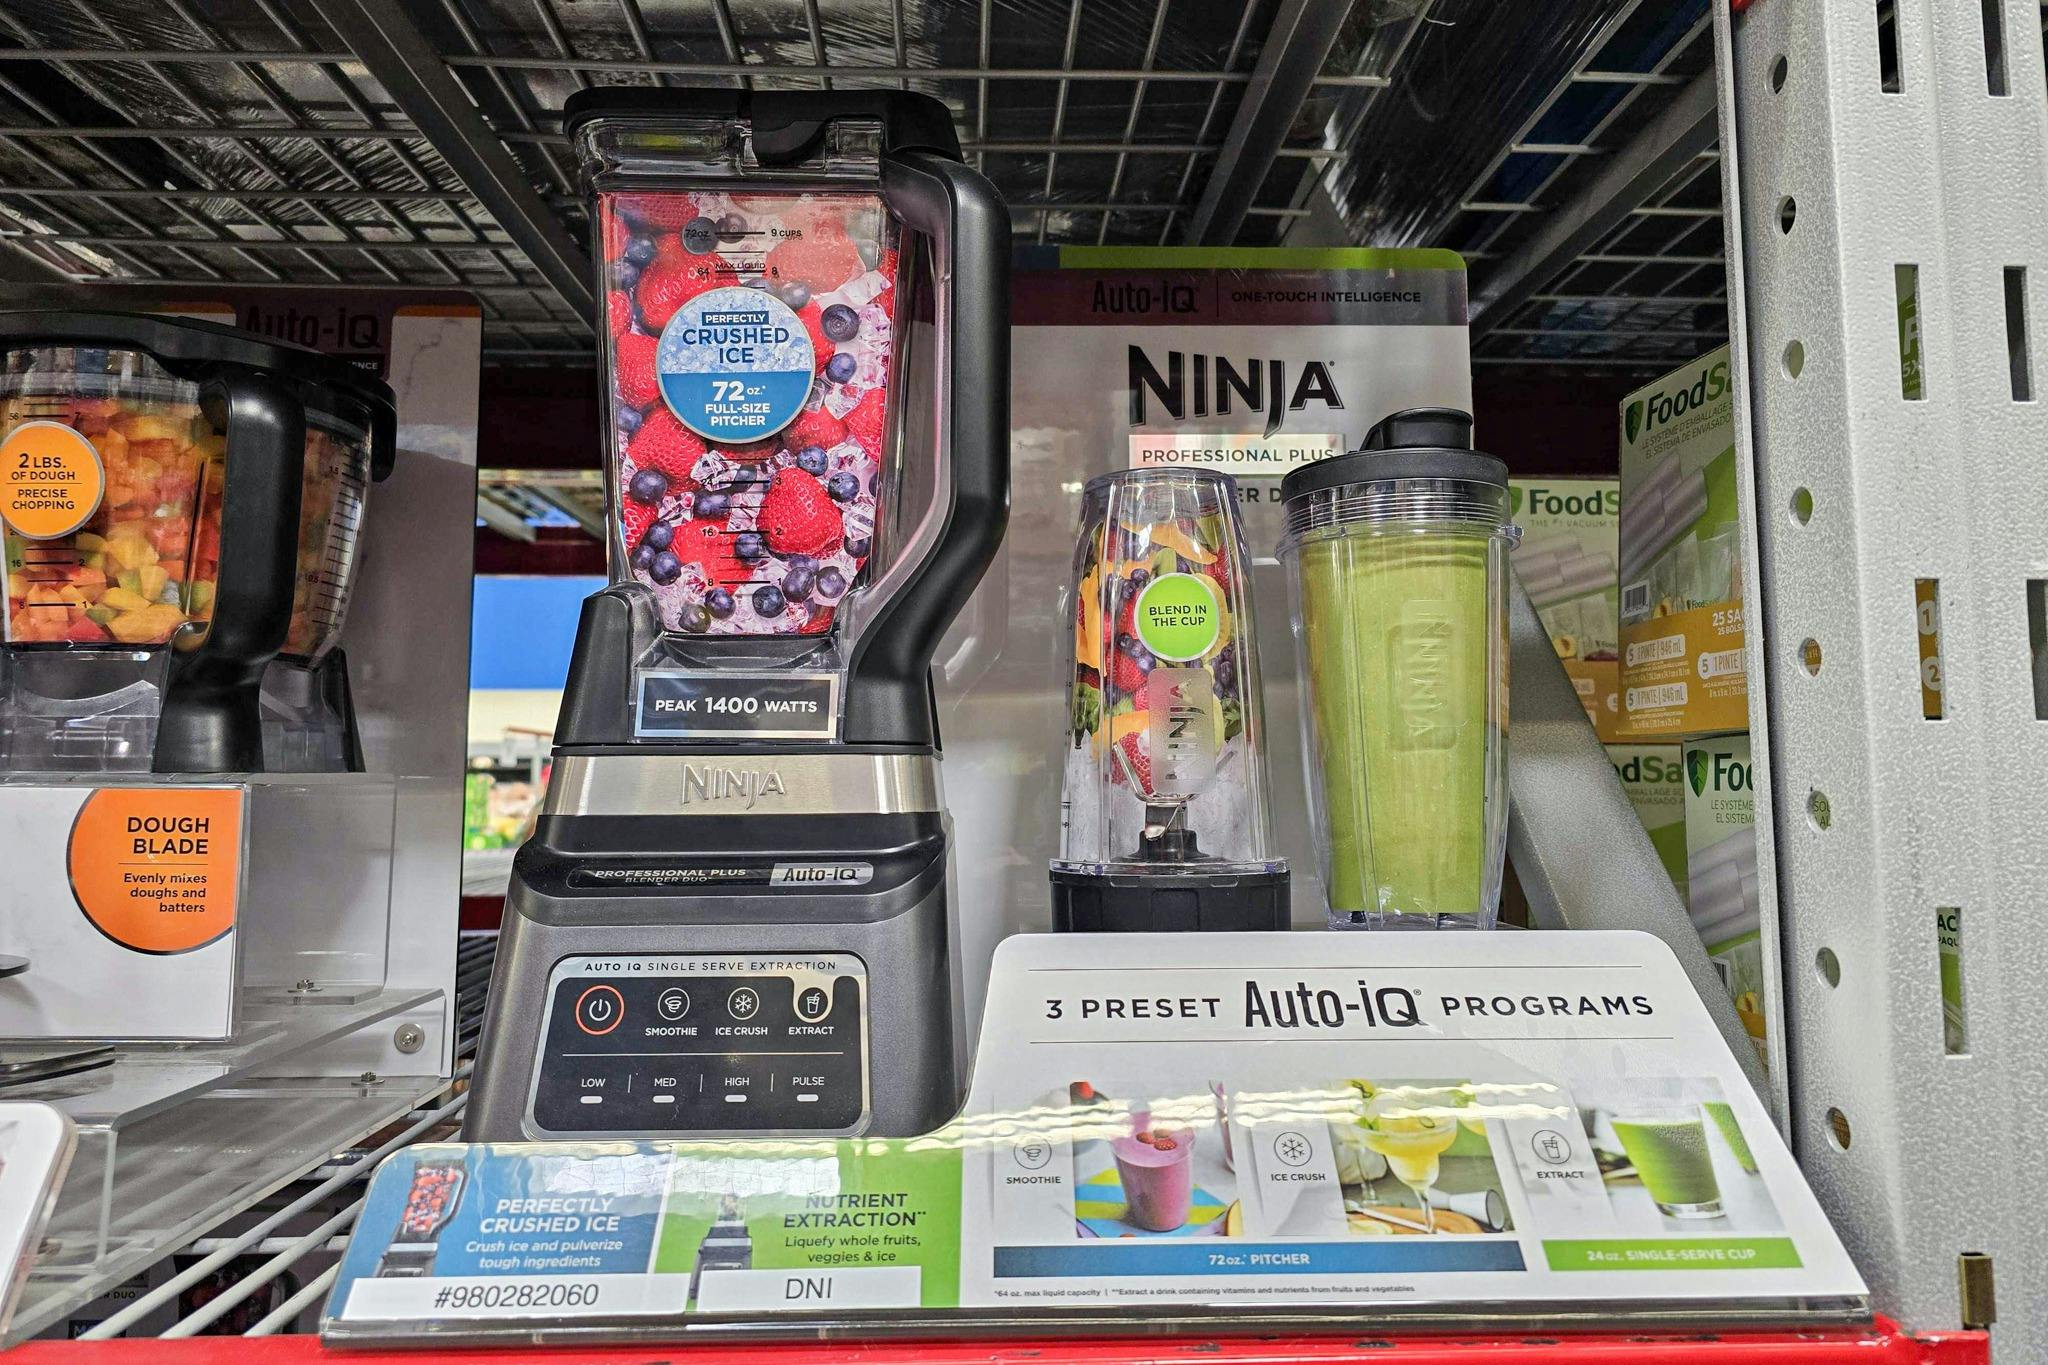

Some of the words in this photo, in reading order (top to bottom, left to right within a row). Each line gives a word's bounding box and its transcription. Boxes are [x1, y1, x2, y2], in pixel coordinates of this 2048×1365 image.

[771, 229, 777, 237] 9
[779, 230, 802, 238] CUPS
[698, 267, 709, 276] 64
[771, 267, 778, 275] 8
[1231, 291, 1317, 303] ONE-TOUCH
[1321, 291, 1422, 303] INTELLIGENCE
[705, 314, 766, 324] PERFECTLY
[682, 328, 790, 345] CRUSHED
[719, 347, 755, 364] ICE
[712, 381, 745, 402] 72
[705, 403, 771, 415] FULL-SIZE
[711, 416, 766, 427] PITCHER
[19, 453, 29, 468] 2
[33, 457, 66, 468] LBS.
[1142, 449, 1283, 462] PROFESSIONAL
[1290, 449, 1334, 462] PLUS
[11, 471, 26, 480] OF
[30, 471, 75, 481] DOUGH
[18, 489, 67, 498] PRECISE
[12, 500, 75, 510] CHOPPING
[702, 527, 714, 537] 16
[776, 528, 783, 536] 2
[708, 578, 714, 587] 8
[1149, 605, 1191, 616] BLEND
[1195, 605, 1207, 614] IN
[1152, 616, 1177, 627] THE
[1181, 616, 1205, 625] CUP
[1712, 611, 1725, 627] 25
[1727, 608, 1744, 624] SA
[1922, 608, 1930, 627] 1
[1629, 644, 1634, 662] 5
[1702, 658, 1709, 673] 5
[1718, 653, 1739, 670] PINTE
[1928, 664, 1941, 683] 2
[655, 700, 696, 711] PEAK
[705, 697, 758, 713] 1400
[764, 701, 817, 712] WATTS
[1629, 692, 1634, 707] 5
[1613, 756, 1682, 783] dSa
[682, 763, 786, 810] NINJA
[1711, 800, 1718, 809] LE
[1716, 813, 1724, 823] EL
[127, 817, 209, 833] DOUGH
[133, 838, 208, 854] BLADE
[124, 873, 166, 884] Evenly
[170, 873, 207, 883] mixes
[130, 888, 178, 899] doughs
[182, 888, 206, 898] and
[159, 902, 205, 912] batters
[585, 963, 621, 971] AUTO
[627, 963, 641, 971] IQ
[648, 962, 695, 971] SINGLE
[702, 962, 744, 970] SERVE
[751, 962, 836, 970] EXTRACTION
[1046, 1000, 1063, 1019] 3
[1082, 998, 1221, 1018] PRESET
[1440, 996, 1654, 1016] PROGRAMS
[645, 1027, 697, 1036] SMOOTHIE
[715, 1027, 732, 1036] ICE
[735, 1027, 768, 1035] CRUSH
[788, 1026, 834, 1035] EXTRACT
[581, 1078, 606, 1087] LOW
[654, 1077, 677, 1087] MED
[725, 1077, 750, 1086] HIGH
[792, 1077, 824, 1086] PULSE
[1006, 1175, 1062, 1184] SMOOTHIE
[1271, 1173, 1288, 1181] ICE
[1291, 1172, 1326, 1181] CRUSH
[1536, 1170, 1585, 1179] EXTRACT
[496, 1198, 613, 1214] PERFECTLY
[805, 1193, 908, 1209] NUTRIENT
[480, 1217, 580, 1233] CRUSHED
[585, 1216, 620, 1231] ICE
[466, 1240, 505, 1253] Crush
[509, 1240, 530, 1251] ice
[533, 1240, 558, 1251] and
[560, 1238, 623, 1252] pulverize
[785, 1236, 835, 1249] Liquefy
[840, 1235, 880, 1246] whole
[883, 1234, 921, 1247] fruits,
[808, 1253, 860, 1264] veggies
[864, 1252, 873, 1262] &
[877, 1252, 896, 1262] ice
[1250, 1253, 1310, 1265] PITCHER
[1587, 1250, 1605, 1262] 24
[1626, 1249, 1725, 1261] SINGLE-SERVE
[1727, 1249, 1756, 1261] CUP
[479, 1256, 520, 1270] tough
[523, 1255, 601, 1268] ingredients
[434, 1280, 599, 1309] #980282060
[785, 1277, 833, 1300] DNI
[1042, 1289, 1065, 1298] liquid
[1066, 1288, 1101, 1298] capacity
[1156, 1287, 1176, 1295] drink
[1178, 1286, 1220, 1295] containing
[1222, 1286, 1256, 1294] vitamins
[1257, 1286, 1272, 1294] and
[1273, 1285, 1309, 1293] nutrients
[1311, 1285, 1331, 1293] from
[1331, 1284, 1353, 1292] fruits
[1355, 1284, 1370, 1292] and
[1372, 1284, 1415, 1293] vegetables
